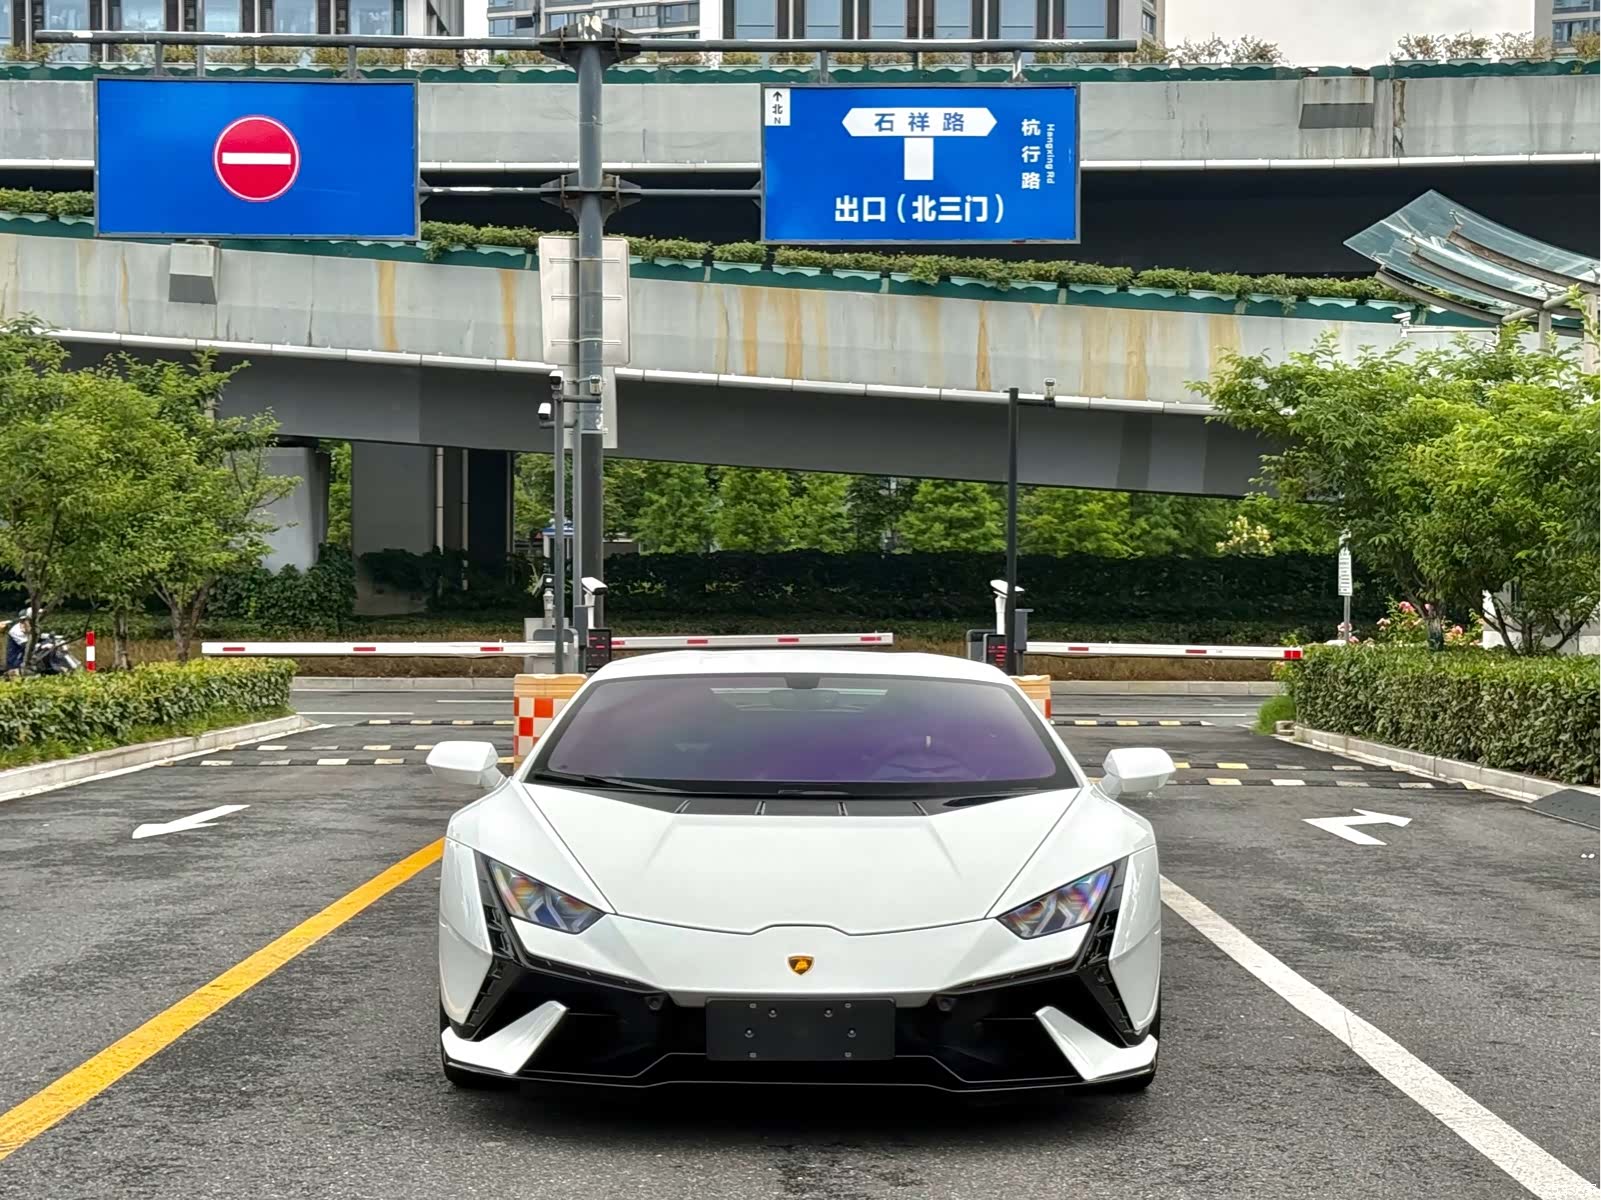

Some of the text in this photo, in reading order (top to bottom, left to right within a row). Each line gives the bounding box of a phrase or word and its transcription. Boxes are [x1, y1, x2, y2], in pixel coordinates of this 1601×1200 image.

[772, 103, 783, 115] 北
[773, 116, 782, 125] N
[874, 112, 965, 133] 石祥路
[1021, 118, 1042, 190] 杭行路
[1044, 123, 1056, 185] Hangxing Rd
[834, 192, 1005, 224] 出口（北三门）
